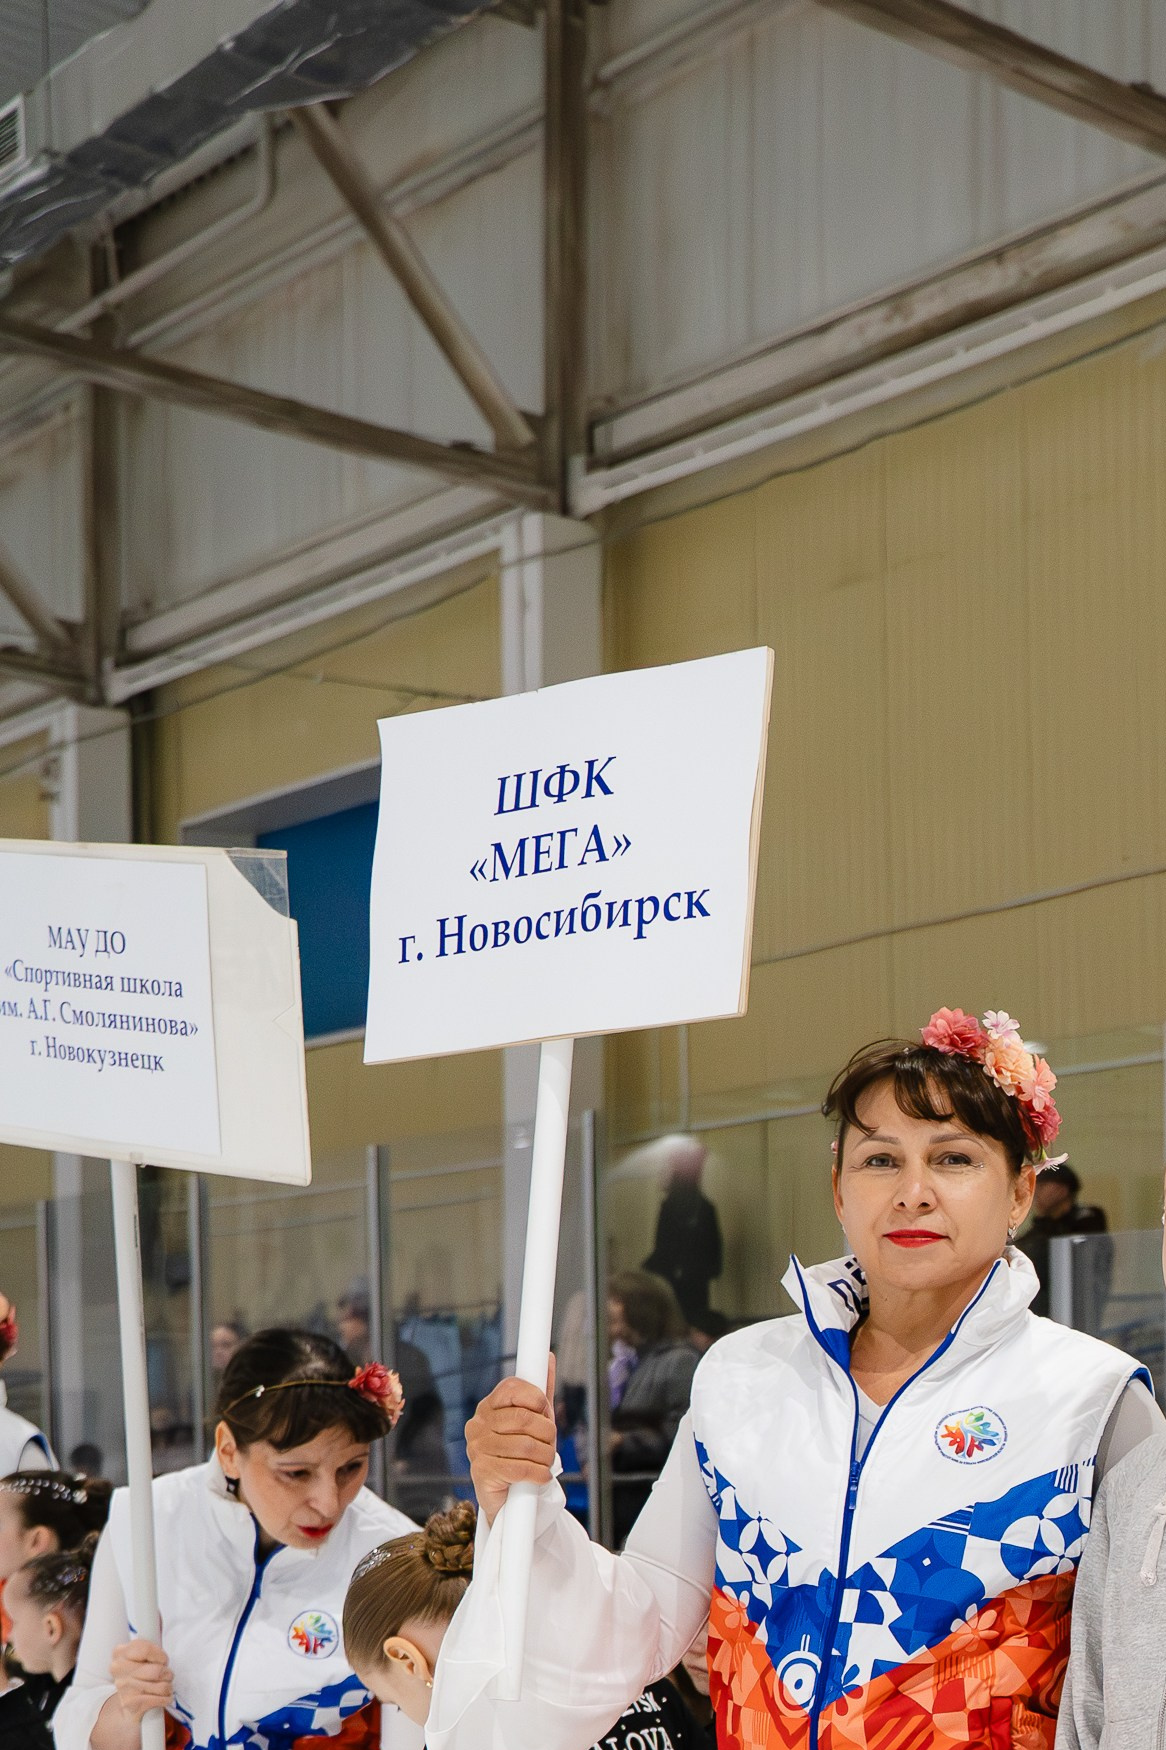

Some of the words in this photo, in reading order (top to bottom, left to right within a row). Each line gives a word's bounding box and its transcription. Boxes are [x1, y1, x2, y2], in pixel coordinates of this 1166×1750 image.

[494, 756, 617, 816] ШФК
[469, 824, 632, 882] «МЕГА»
[48, 925, 89, 957] МАУ
[94, 930, 126, 959] ДО
[398, 935, 423, 964] г.
[435, 888, 711, 958] Новосибирск
[4, 959, 114, 992] «Спортивная
[120, 977, 184, 998] школа
[27, 997, 56, 1021] А.Г.
[60, 1001, 198, 1037] Смолянинова»
[30, 1040, 42, 1056] г.
[45, 1036, 165, 1073] Новокузнецк
